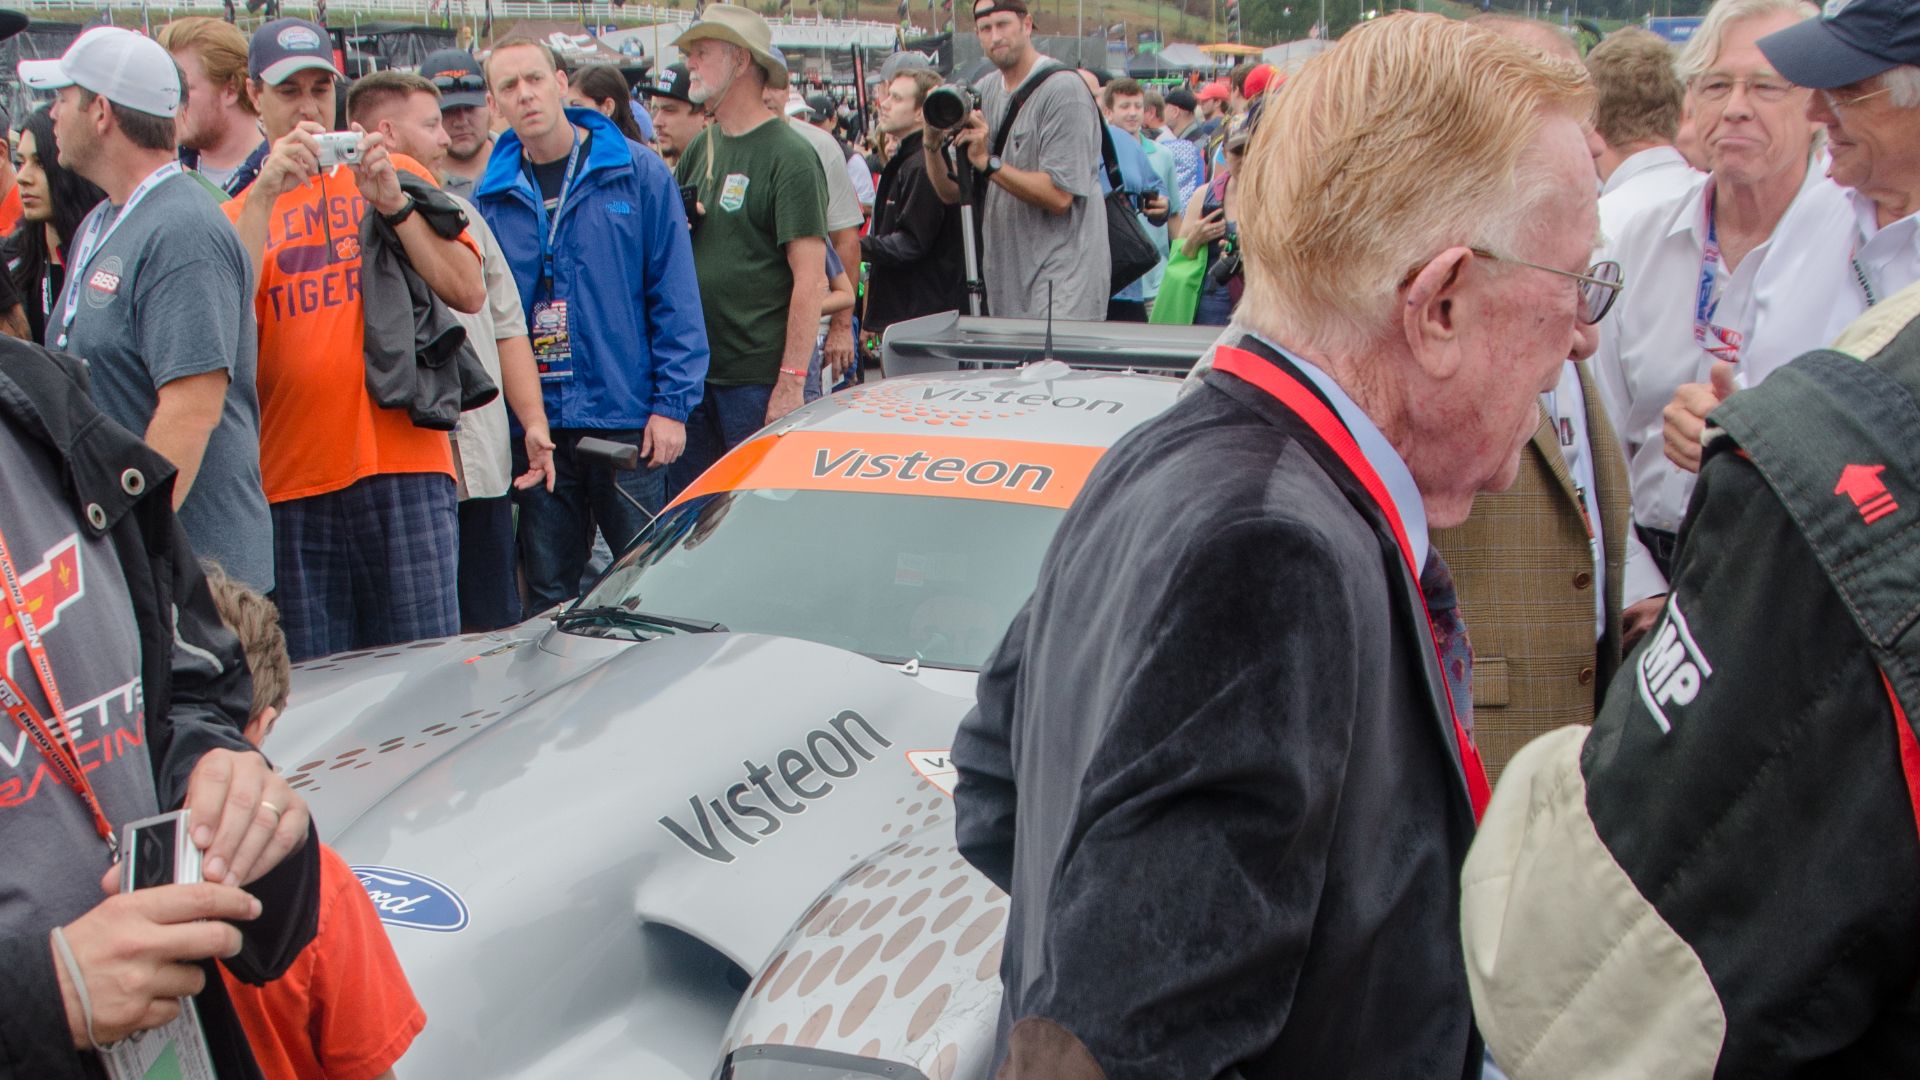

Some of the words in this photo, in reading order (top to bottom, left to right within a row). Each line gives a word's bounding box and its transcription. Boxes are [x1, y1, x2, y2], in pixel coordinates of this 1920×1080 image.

[90, 271, 120, 291] BBS
[921, 386, 1125, 415] Visteon
[812, 448, 1055, 493] Visteon
[17, 610, 42, 649] NOS
[1644, 613, 1700, 706] MP
[0, 677, 24, 708] OS
[18, 711, 53, 752] ENERGY
[657, 708, 894, 864] Visteon
